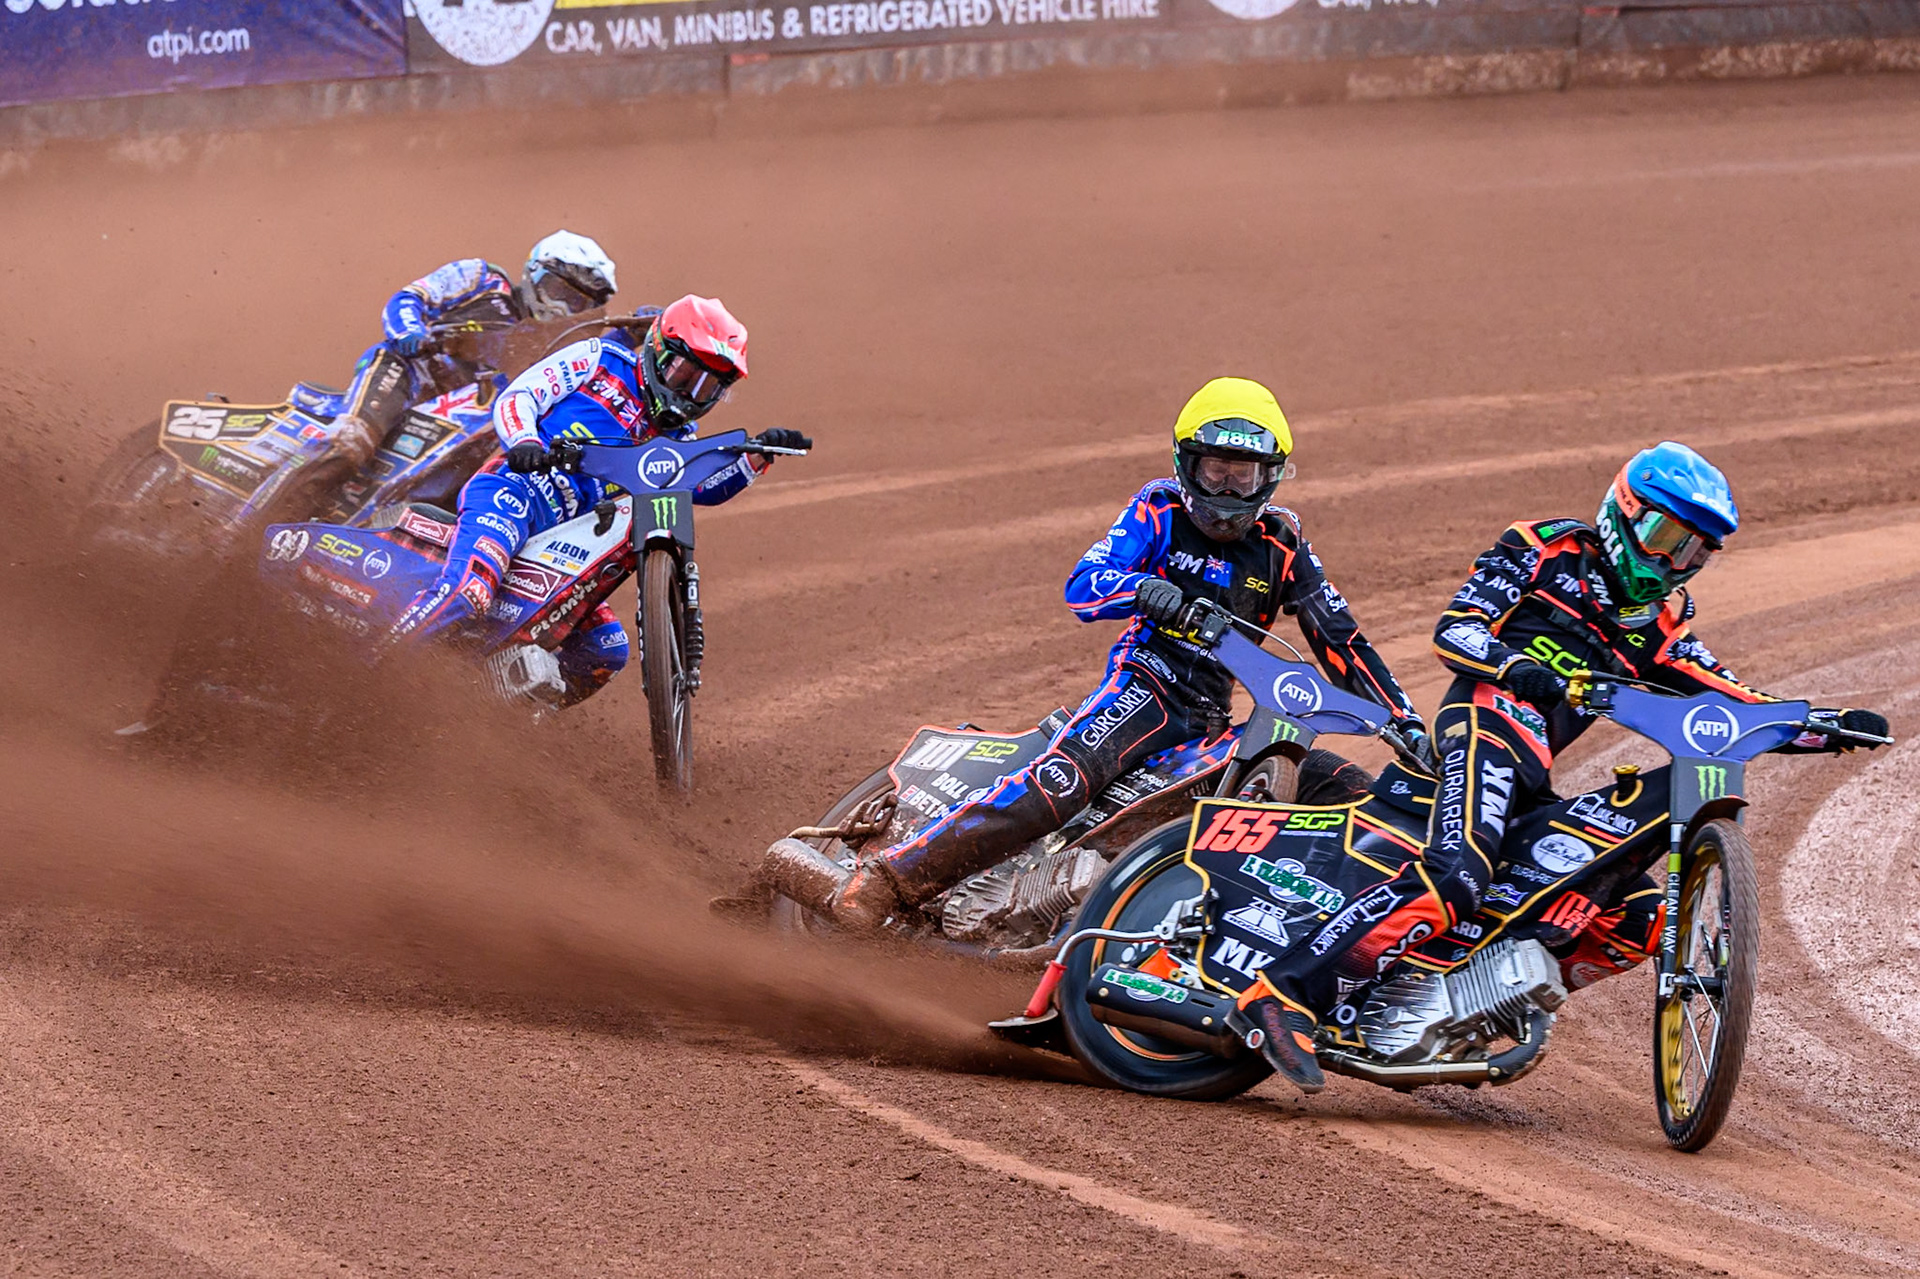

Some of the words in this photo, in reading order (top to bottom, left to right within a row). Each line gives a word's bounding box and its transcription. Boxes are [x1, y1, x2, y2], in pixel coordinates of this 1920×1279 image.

[545, 20, 602, 56] CAR,
[606, 16, 668, 50] VAN,
[674, 8, 775, 46] MINIBUS
[780, 7, 804, 39] &
[810, 0, 992, 36] REFRIGERATED
[998, 0, 1098, 25] VEHICLE
[147, 27, 250, 64] atpi.com
[167, 406, 228, 440] 25
[1215, 431, 1265, 453] BOLL
[645, 460, 677, 475] ATPI
[498, 491, 525, 515] ATPI
[316, 533, 364, 558] SGP
[545, 540, 590, 562] ALBON
[1280, 683, 1315, 707] ATPI
[1081, 682, 1151, 747] GARCAREK
[1691, 721, 1730, 738] ATPI
[900, 736, 980, 772] 101
[968, 740, 1020, 758] SGP
[931, 771, 970, 800] BOLL
[1044, 764, 1070, 788] ATPI
[1192, 808, 1292, 854] 155
[1284, 812, 1346, 831] SGP
[1665, 873, 1681, 915] CLEAN
[1662, 925, 1678, 954] WAY
